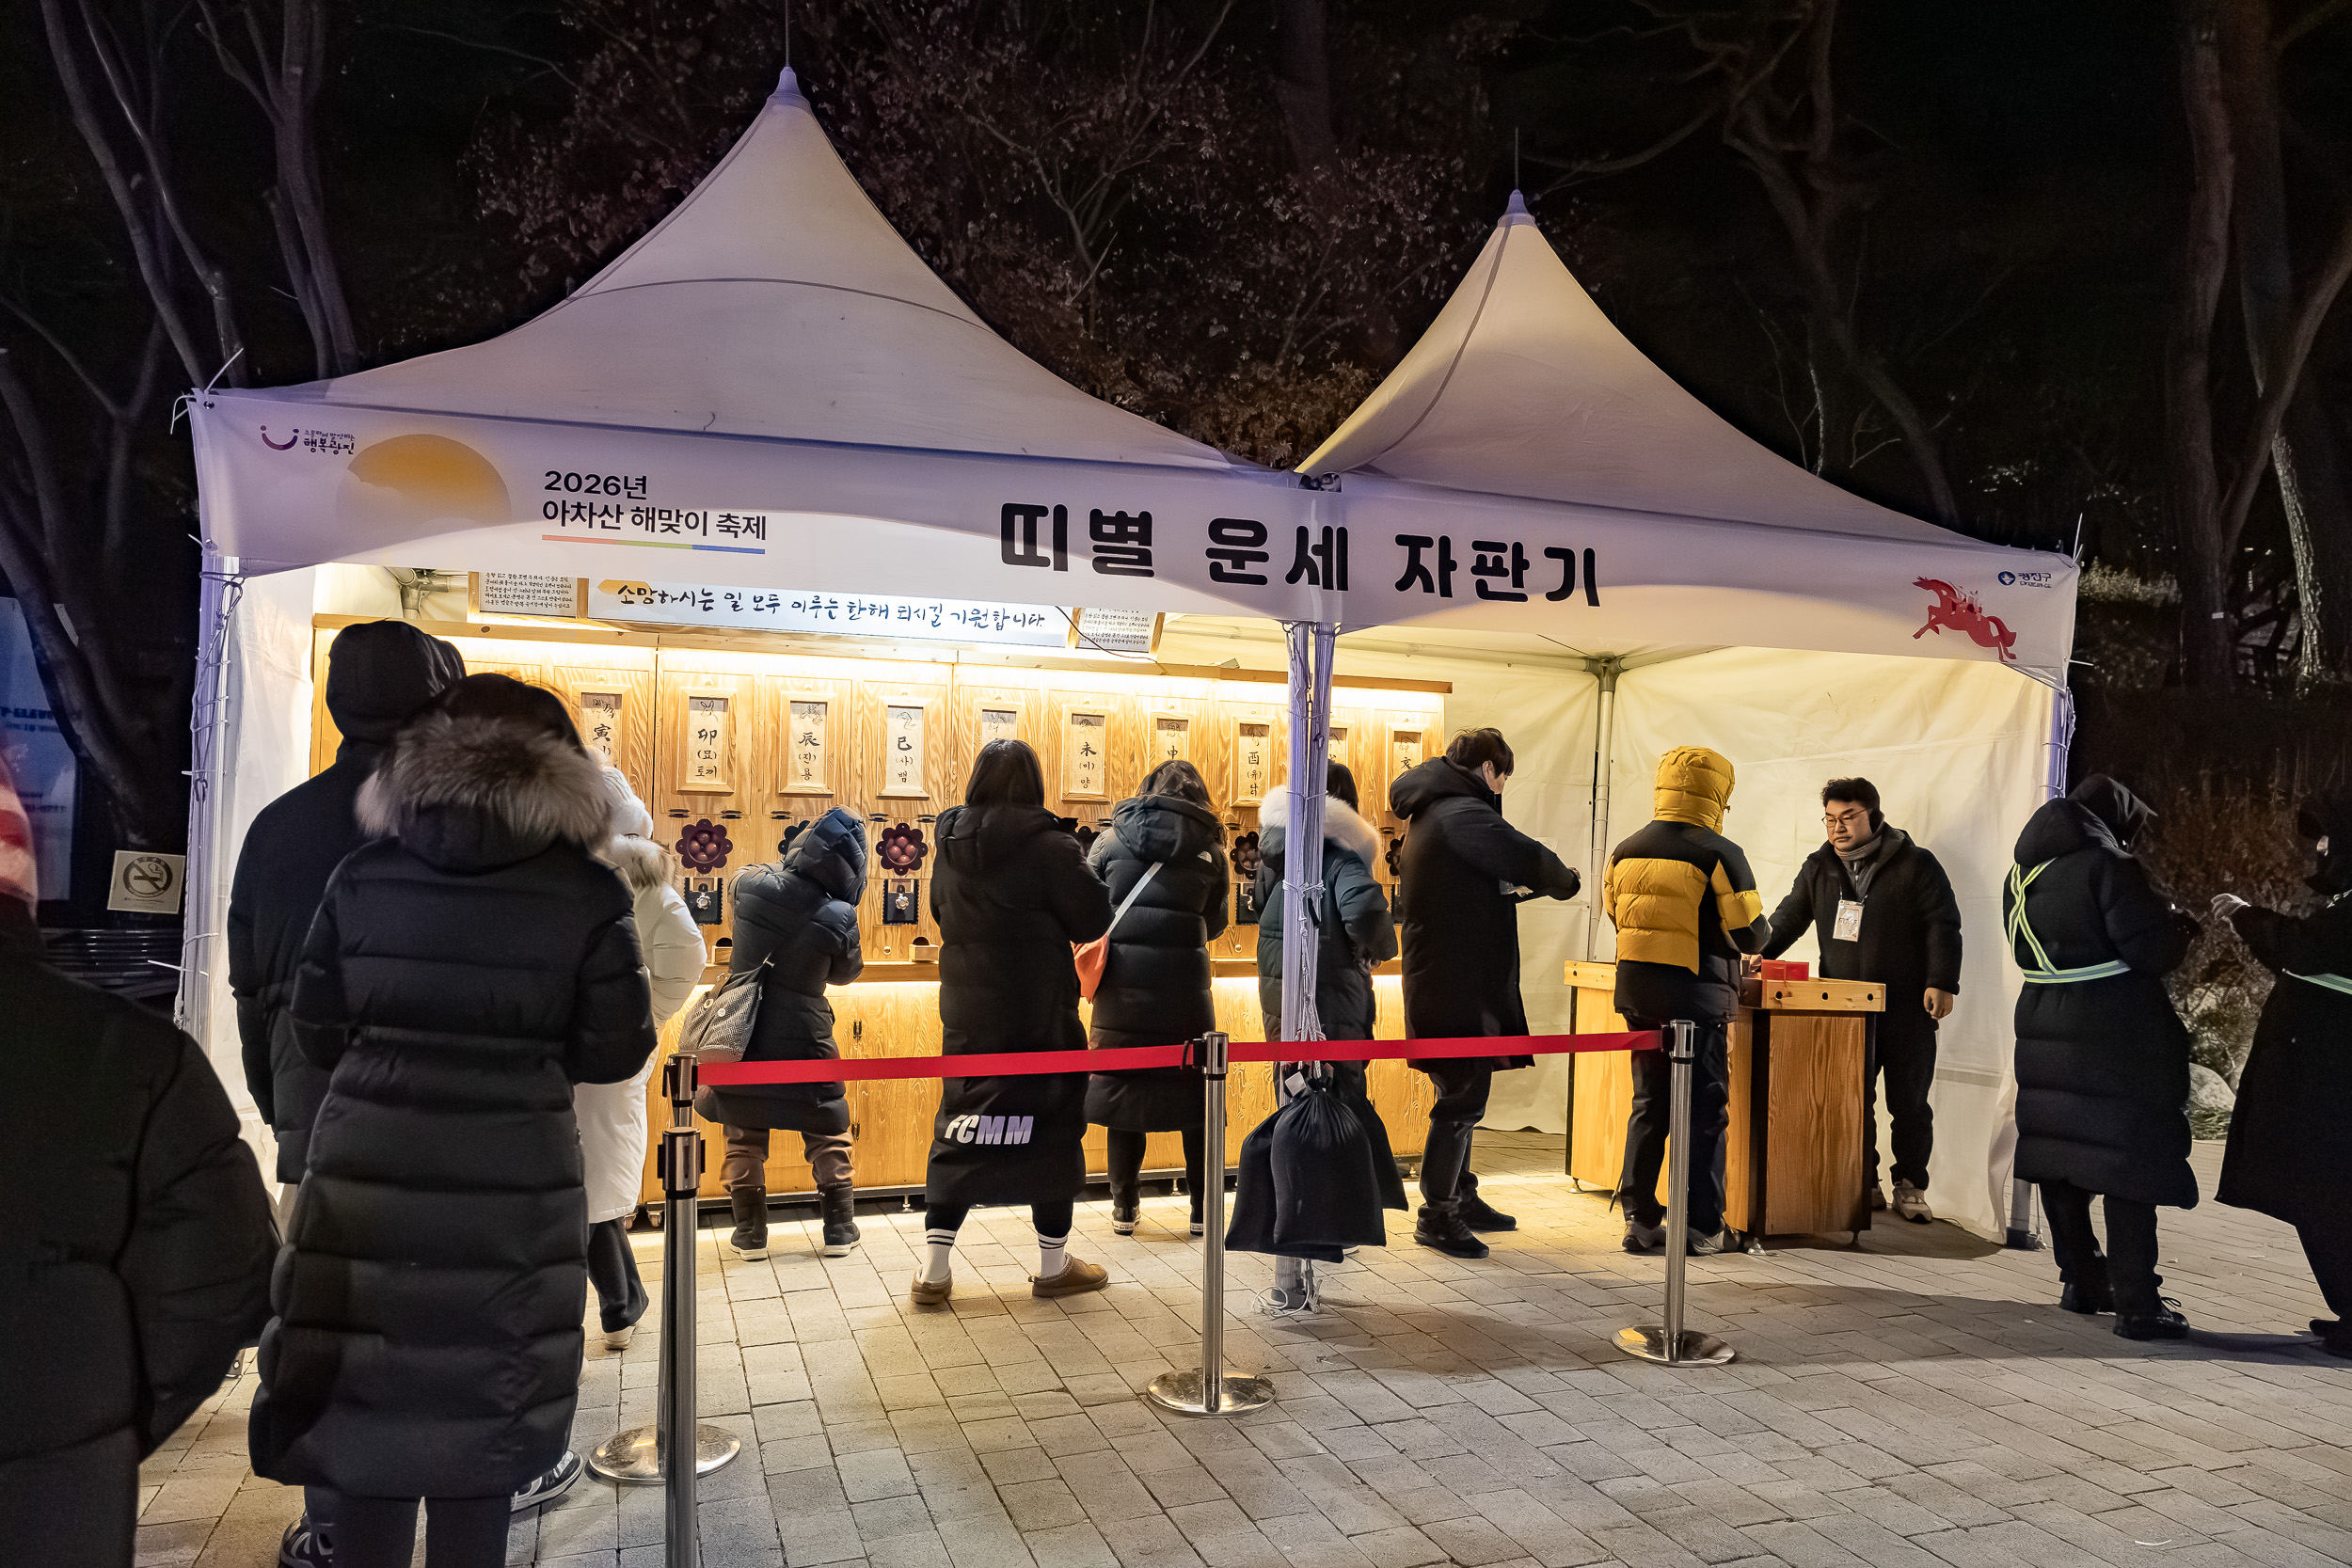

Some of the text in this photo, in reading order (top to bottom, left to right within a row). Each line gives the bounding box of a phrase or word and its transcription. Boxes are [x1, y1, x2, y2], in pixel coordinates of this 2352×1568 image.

[304, 437, 354, 455] 행복광진
[544, 470, 647, 499] 2026년
[542, 499, 766, 540] 아차산 해맞이 축제
[1000, 502, 1601, 607] 띠별 운세 자판기
[2017, 572, 2052, 582] 광진구
[617, 584, 715, 611] 소망하시는
[723, 592, 744, 611] 일
[753, 594, 781, 614] 모두
[791, 595, 839, 620] 이루는
[897, 603, 943, 627] 되시길
[593, 723, 612, 742] 寅
[697, 728, 718, 746] 卯
[798, 732, 820, 747] 辰
[1167, 745, 1179, 760] 申
[694, 766, 717, 778] 토끼
[801, 768, 812, 781] 용
[1080, 776, 1090, 788] 양
[944, 1114, 1034, 1145] FCMM
